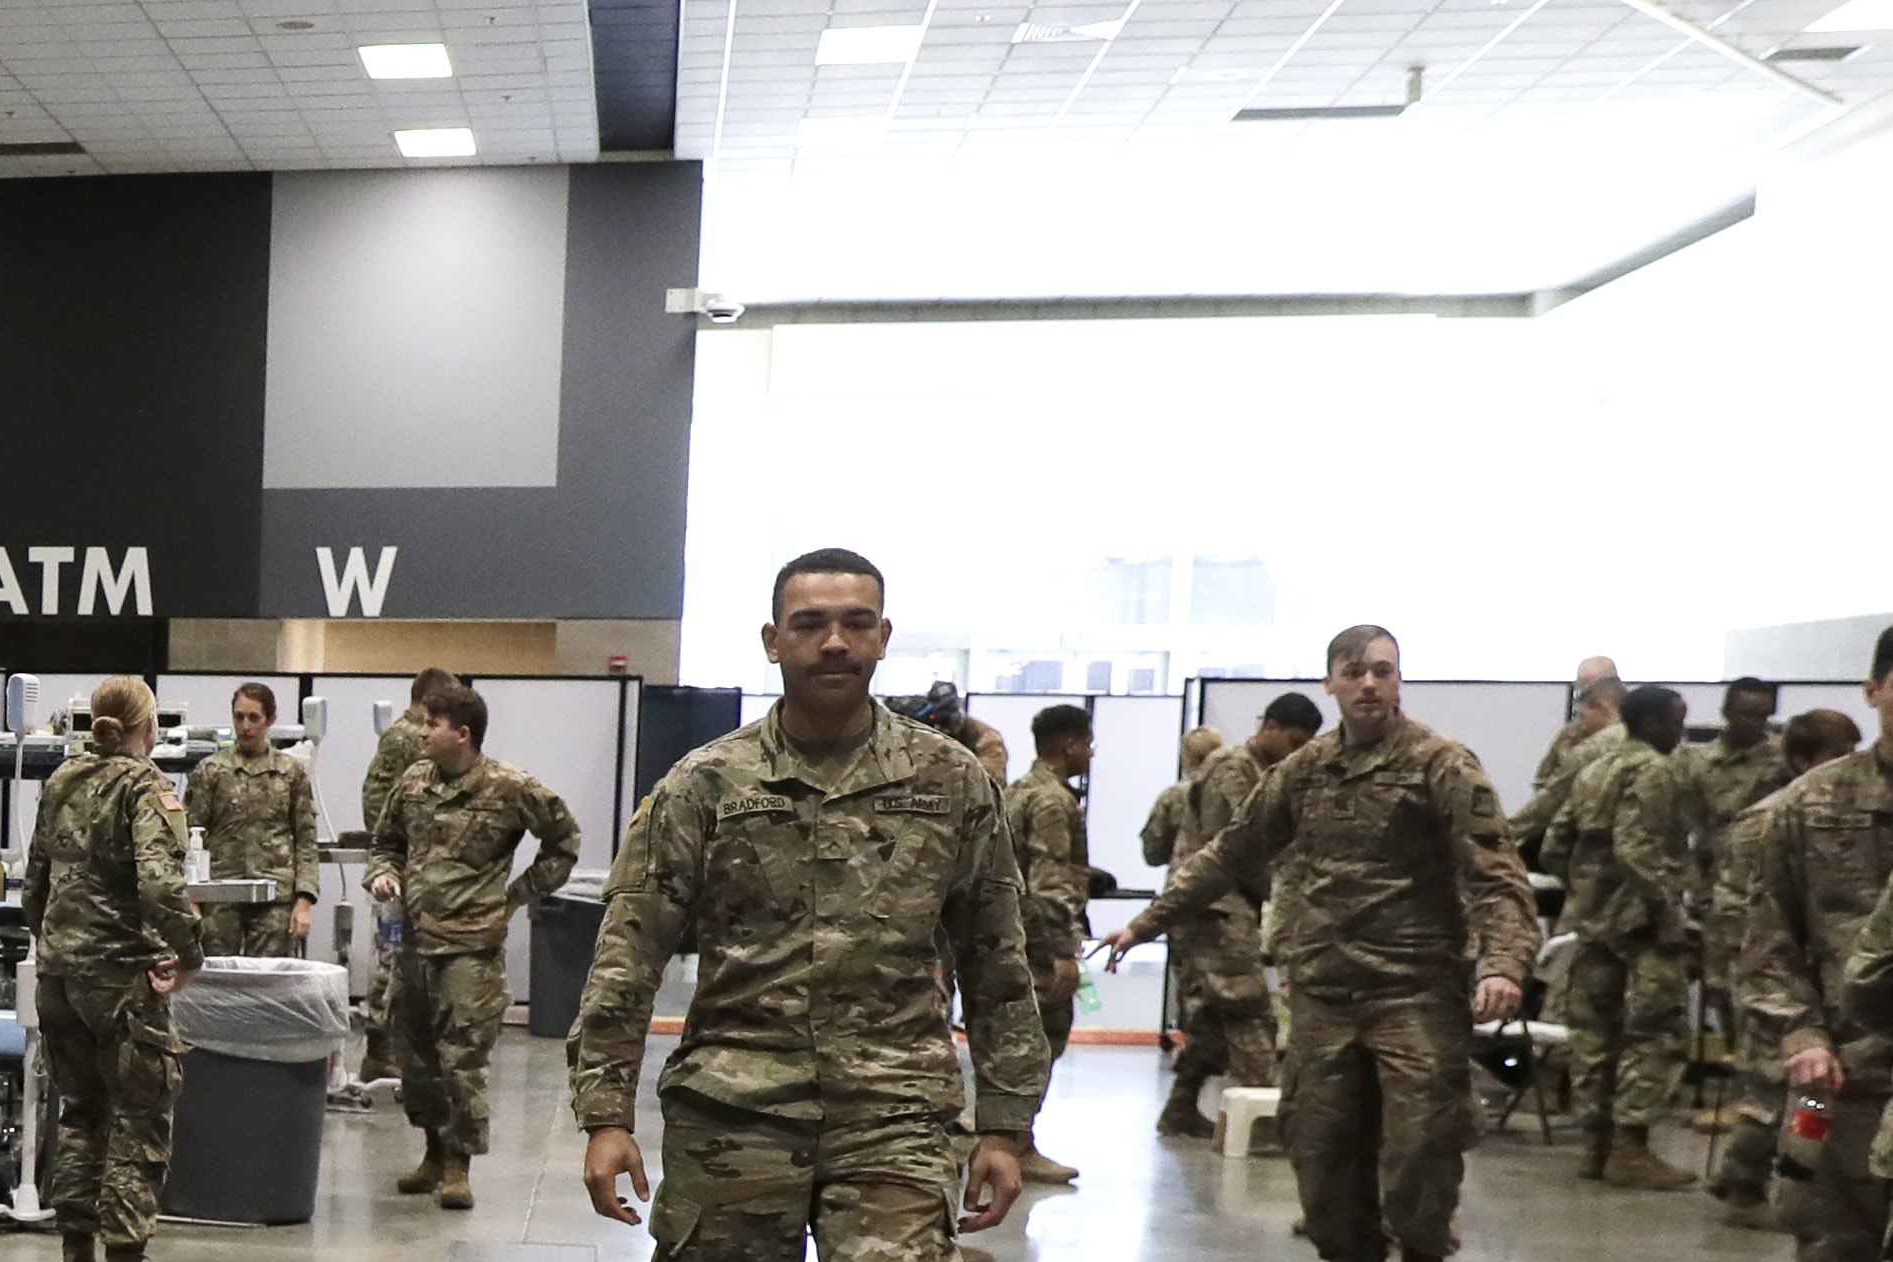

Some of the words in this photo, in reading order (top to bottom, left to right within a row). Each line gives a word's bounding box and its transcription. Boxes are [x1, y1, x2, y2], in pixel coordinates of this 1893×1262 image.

[315, 546, 398, 617] W
[723, 797, 785, 815] BRADFORD
[911, 797, 941, 811] ARMY
